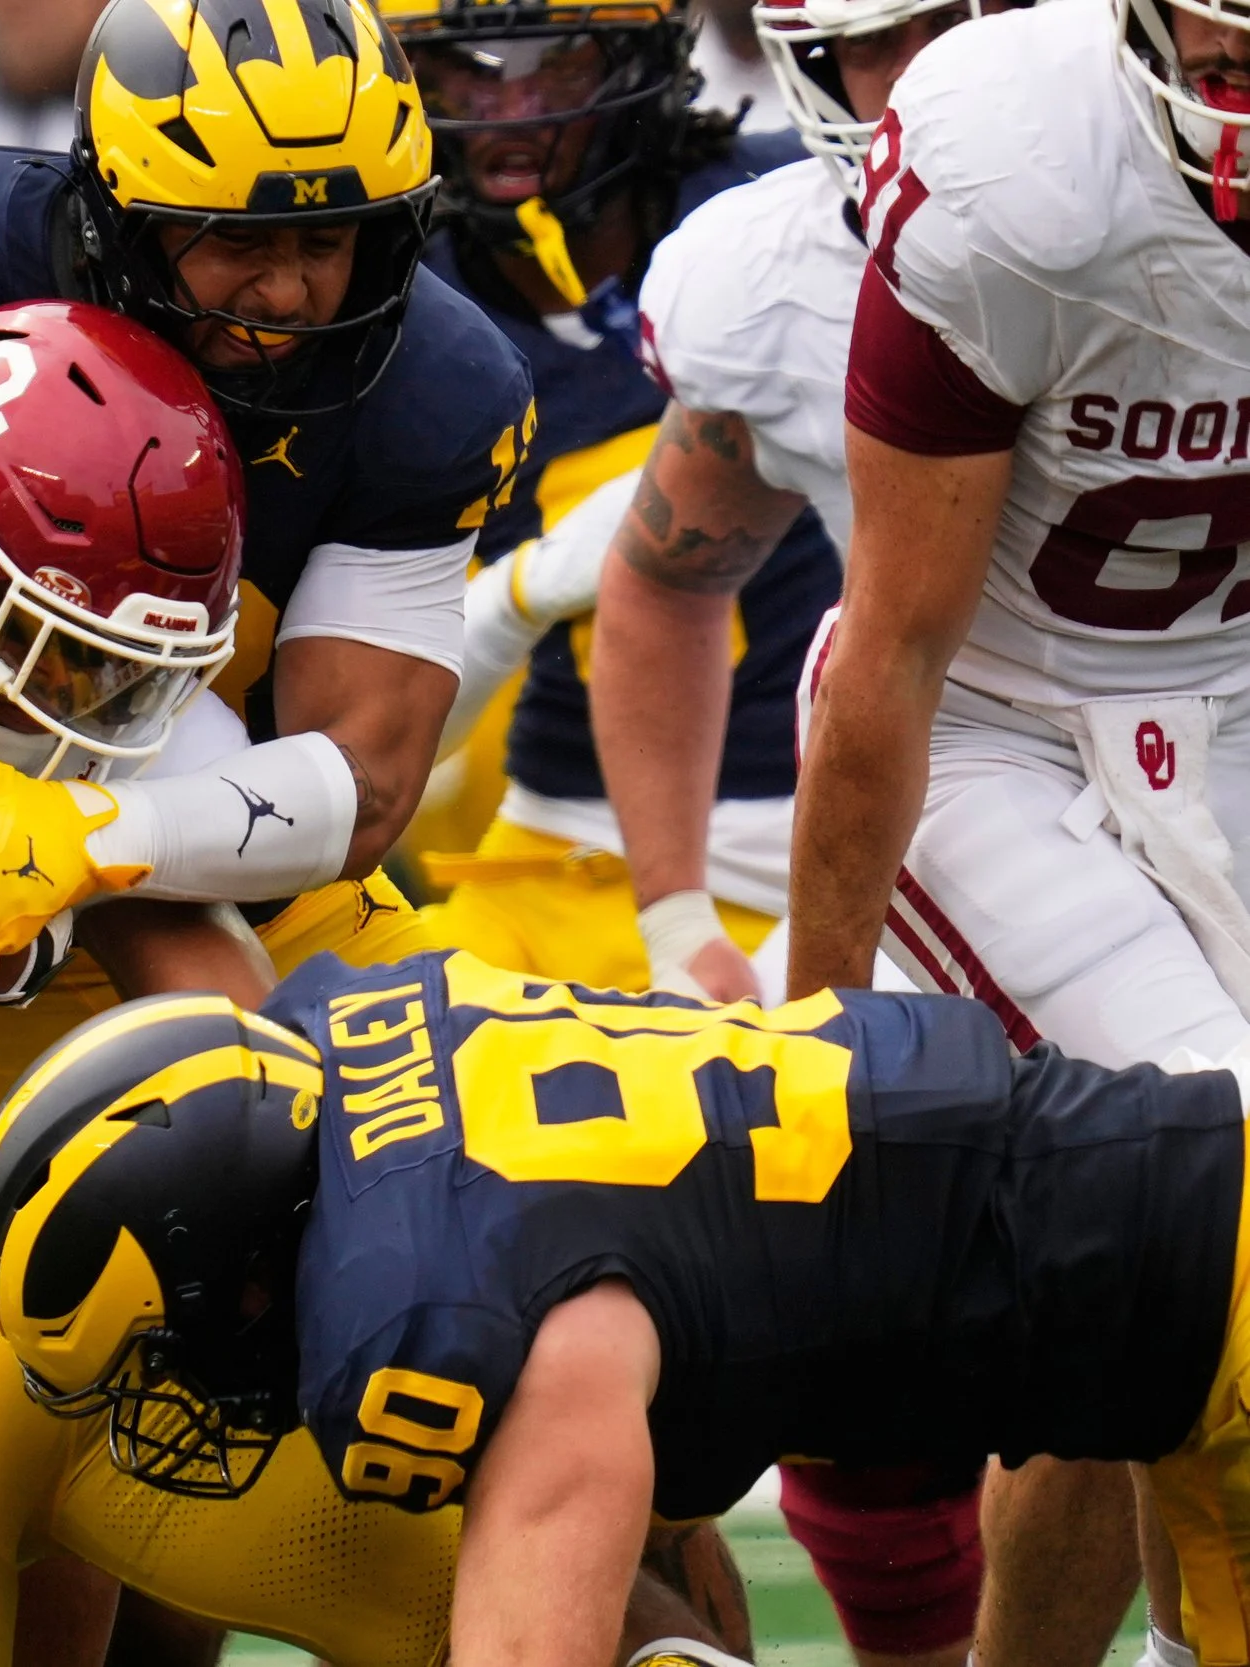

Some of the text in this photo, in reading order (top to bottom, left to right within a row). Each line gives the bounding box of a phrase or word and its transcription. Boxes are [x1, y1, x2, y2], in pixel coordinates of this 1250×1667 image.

[293, 176, 328, 206] M
[1028, 473, 1250, 631] 8
[1135, 720, 1176, 791] OU
[329, 981, 445, 1162] DALEY
[341, 1366, 485, 1508] 90
